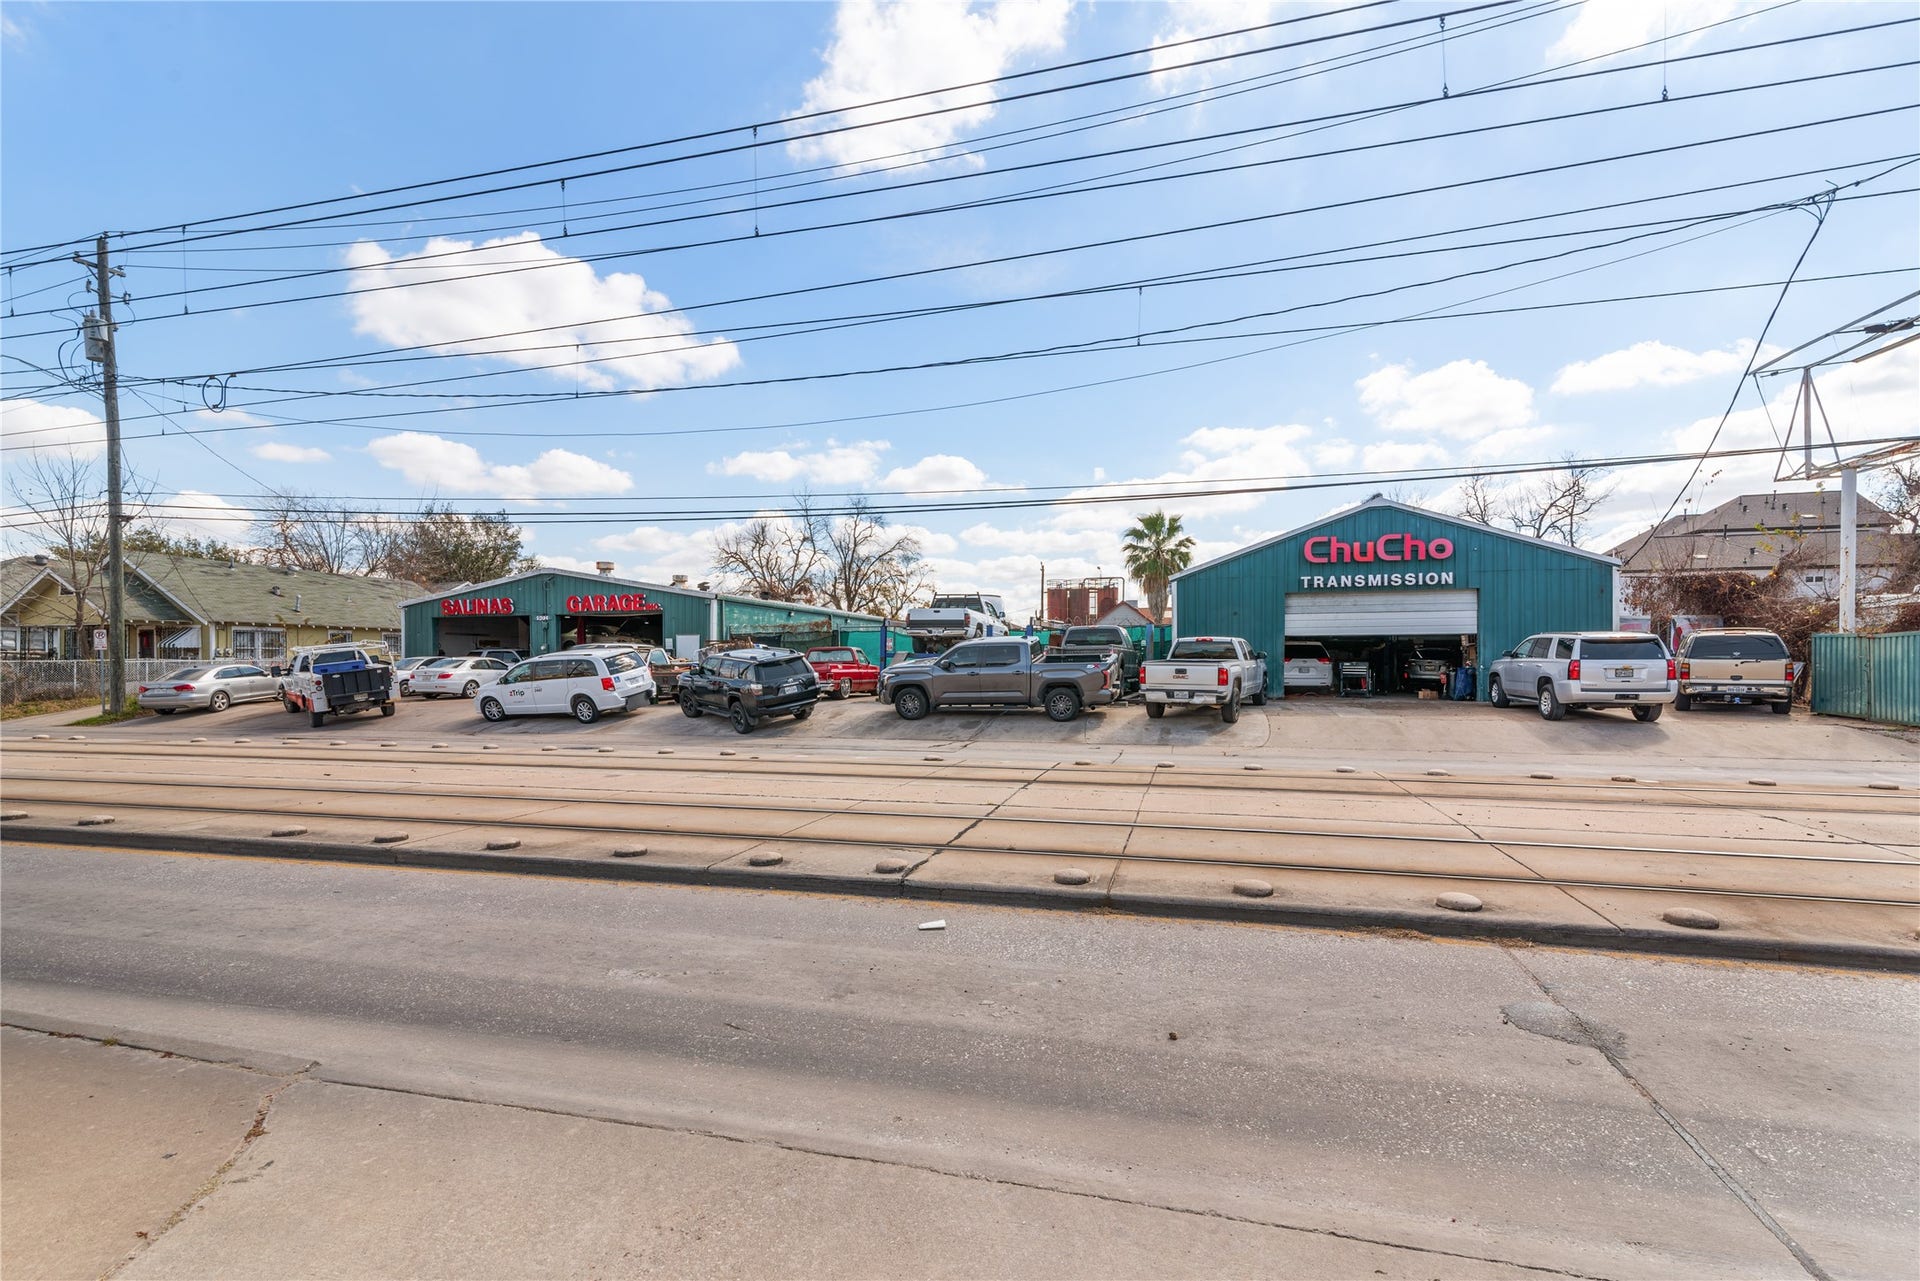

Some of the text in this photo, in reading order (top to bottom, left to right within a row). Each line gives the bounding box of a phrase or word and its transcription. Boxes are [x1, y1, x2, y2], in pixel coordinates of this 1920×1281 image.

[1303, 533, 1454, 563] ChuCho
[1301, 571, 1454, 589] TRANSMISSION
[441, 597, 514, 616] SALINAS
[566, 593, 646, 612] GARAGE
[509, 689, 525, 697] zTrip
